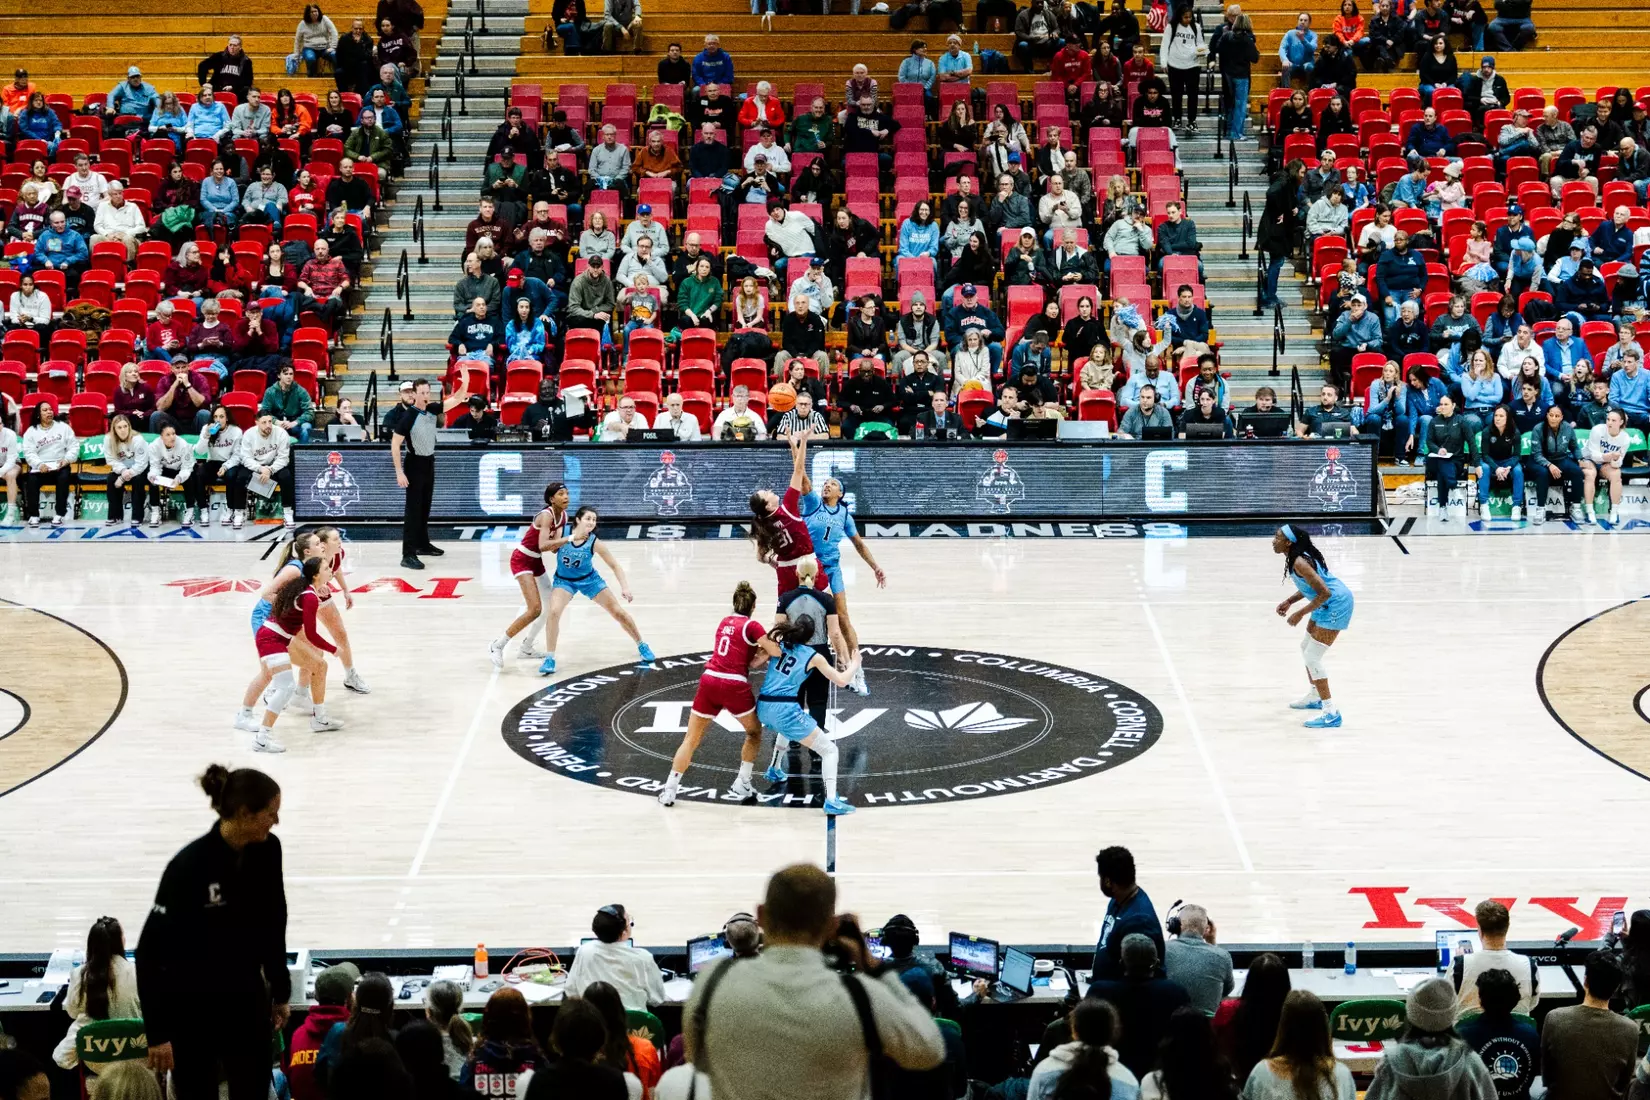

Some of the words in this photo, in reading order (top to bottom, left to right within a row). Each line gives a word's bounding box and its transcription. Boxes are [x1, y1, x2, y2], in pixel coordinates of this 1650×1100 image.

[84, 442, 105, 455] Ivy
[1625, 496, 1648, 504] TIAA
[39, 526, 204, 540] TIAA
[626, 525, 687, 539] IS
[865, 522, 1186, 538] MADNESS
[823, 526, 832, 541] 1
[563, 556, 582, 569] 24
[717, 635, 733, 657] 0
[775, 652, 798, 676] 12
[953, 654, 1108, 694] COLUMBIA
[518, 673, 621, 733] PRINCETON
[1107, 700, 1147, 749] CORNELL
[526, 741, 601, 773] PENN
[864, 756, 1106, 803] DARTMOUTH
[1337, 1015, 1380, 1036] Ivy
[83, 1035, 128, 1057] Ivy
